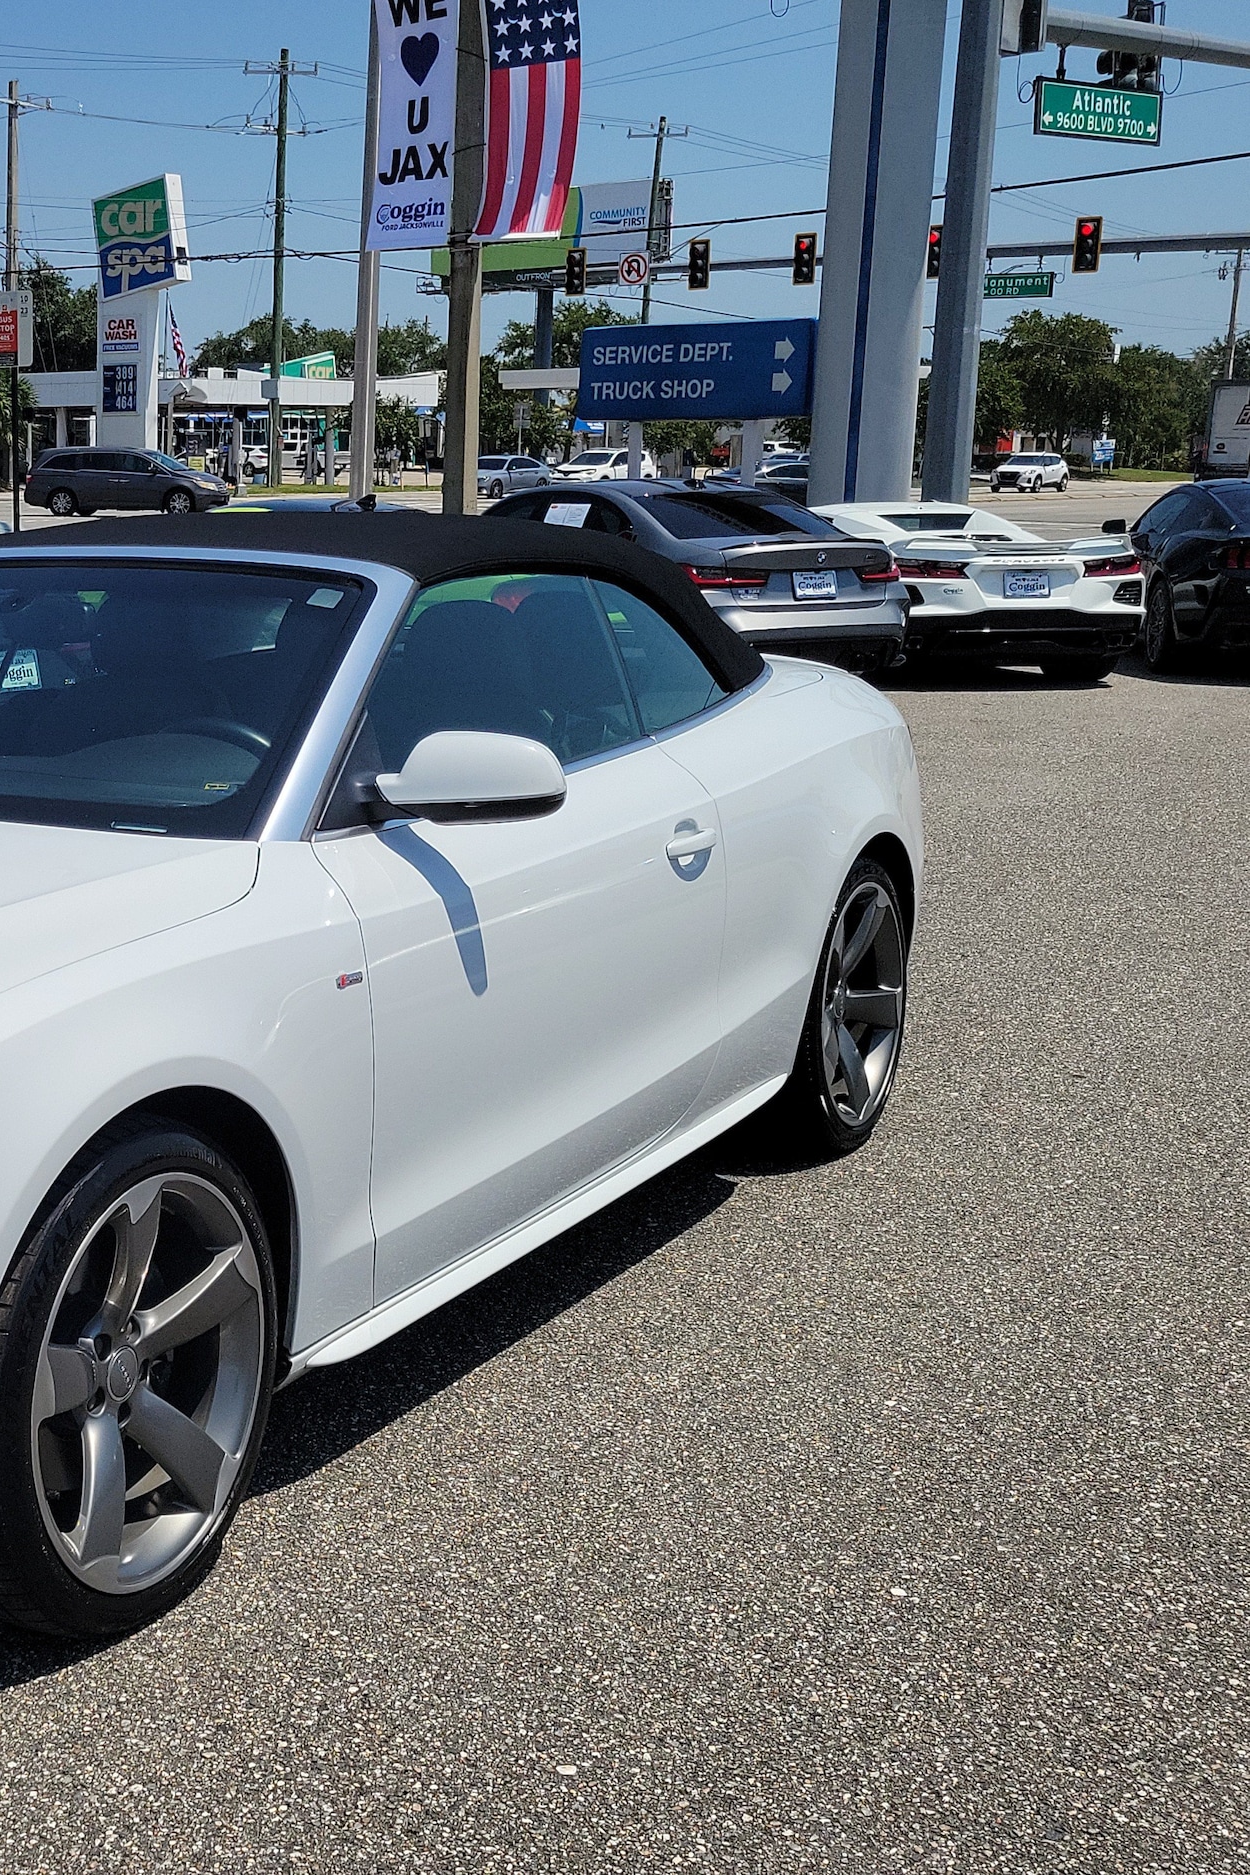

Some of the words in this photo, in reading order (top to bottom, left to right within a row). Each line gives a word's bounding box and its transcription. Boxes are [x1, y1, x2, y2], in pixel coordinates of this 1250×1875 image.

[388, 0, 447, 28] WE
[1072, 90, 1131, 116] Atlantic
[407, 96, 430, 135] U
[1056, 112, 1085, 130] 9600
[1087, 115, 1114, 132] BLVD
[1117, 118, 1144, 136] 9700
[378, 141, 449, 186] JAX
[101, 200, 162, 236] car
[376, 198, 445, 225] Coggin
[590, 206, 647, 221] COMMUNITY
[399, 221, 444, 230] JACKSONVILLE
[623, 217, 646, 227] FIRST
[106, 246, 165, 293] spa
[1006, 287, 1019, 295] RD
[20, 295, 29, 303] 10
[108, 319, 135, 331] CAR
[105, 330, 137, 341] WASH
[592, 344, 674, 365] SERVICE
[679, 342, 733, 363] DEPT.
[115, 366, 134, 380] 389
[591, 381, 655, 400] TRUCK
[660, 379, 715, 399] SHOP
[115, 395, 133, 409] 464
[798, 580, 832, 591] Coggin
[1009, 582, 1046, 592] Coggin
